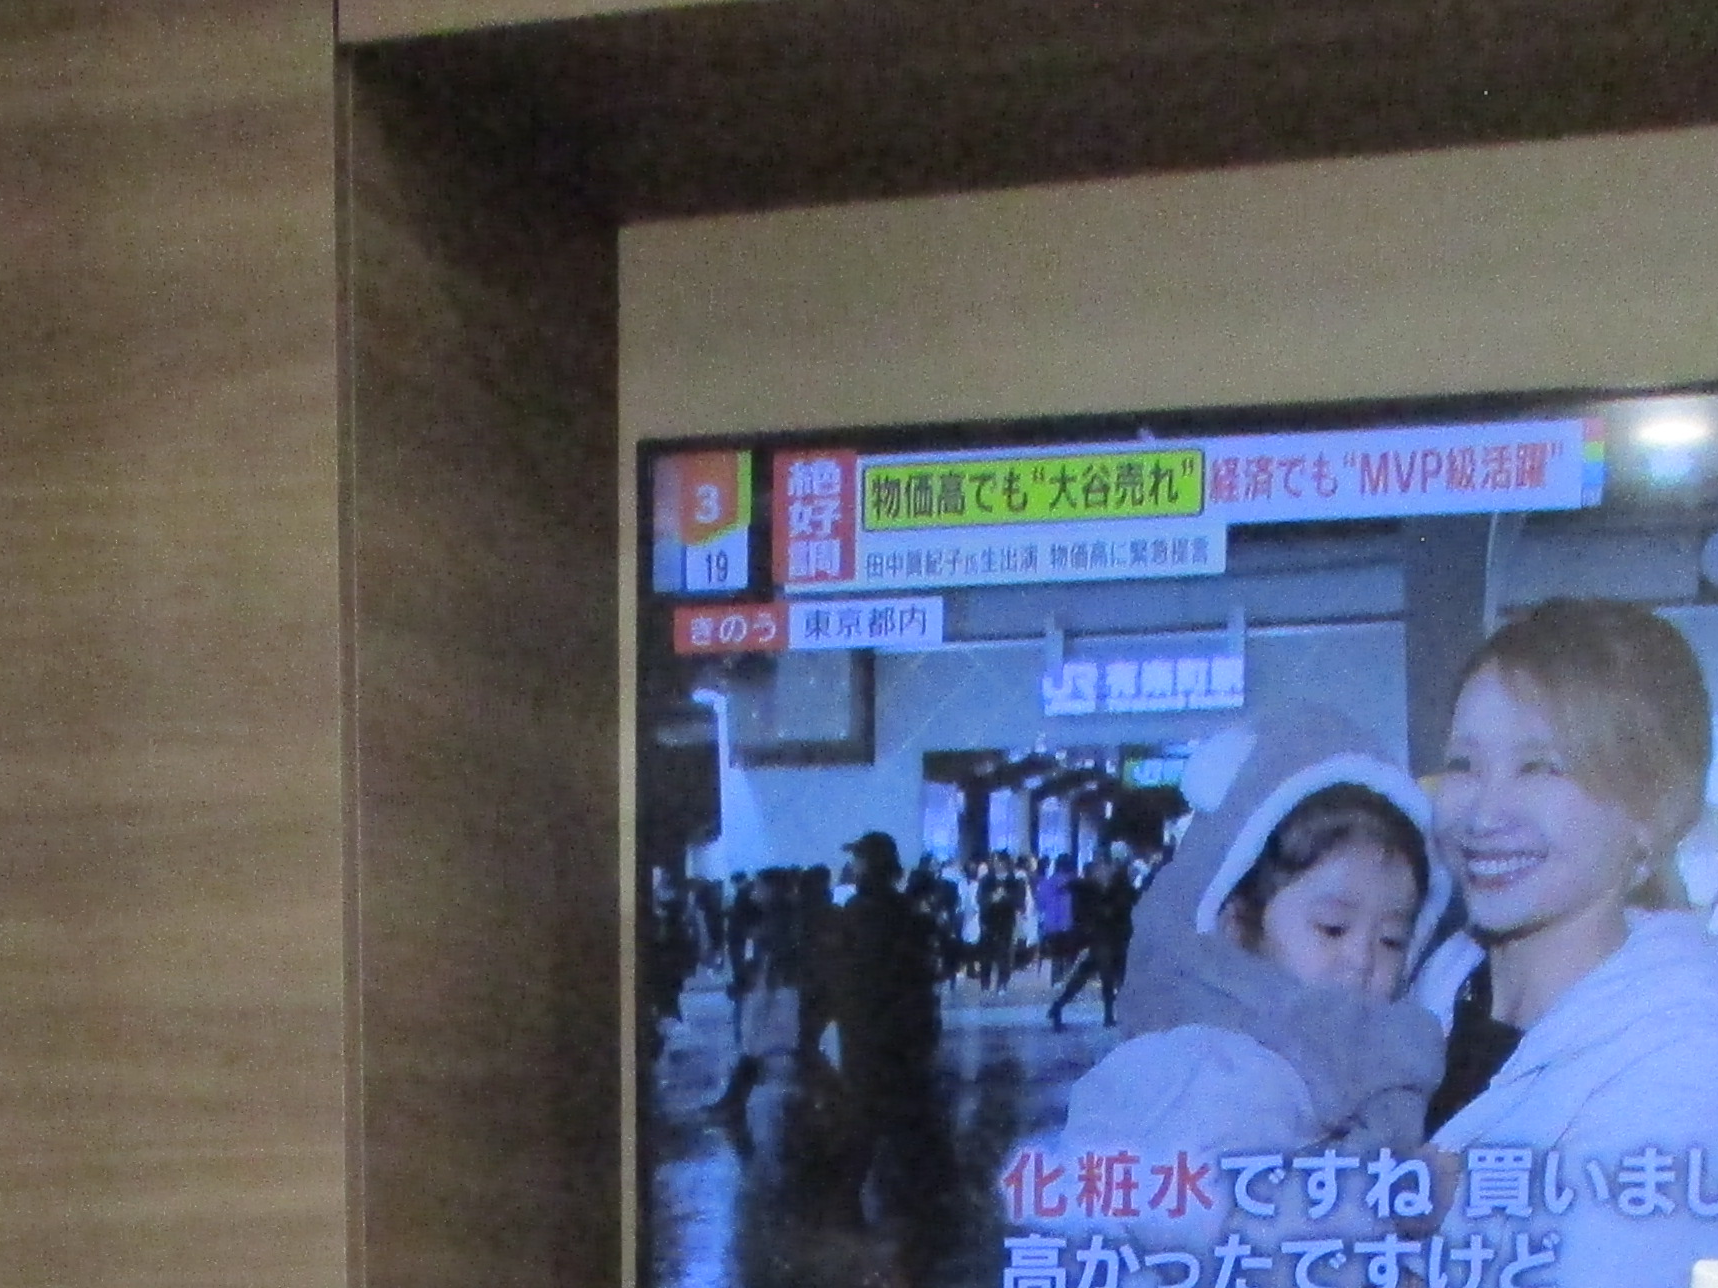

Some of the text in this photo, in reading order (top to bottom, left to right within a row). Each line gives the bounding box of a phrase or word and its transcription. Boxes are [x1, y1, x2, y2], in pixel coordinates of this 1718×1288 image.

[695, 484, 721, 524] 3
[872, 457, 1194, 521] 物価高でも“大谷売れ”
[705, 551, 729, 582] 19
[690, 604, 927, 646] きのう 東京都内
[1004, 1148, 1434, 1219] 化粧水ですね
